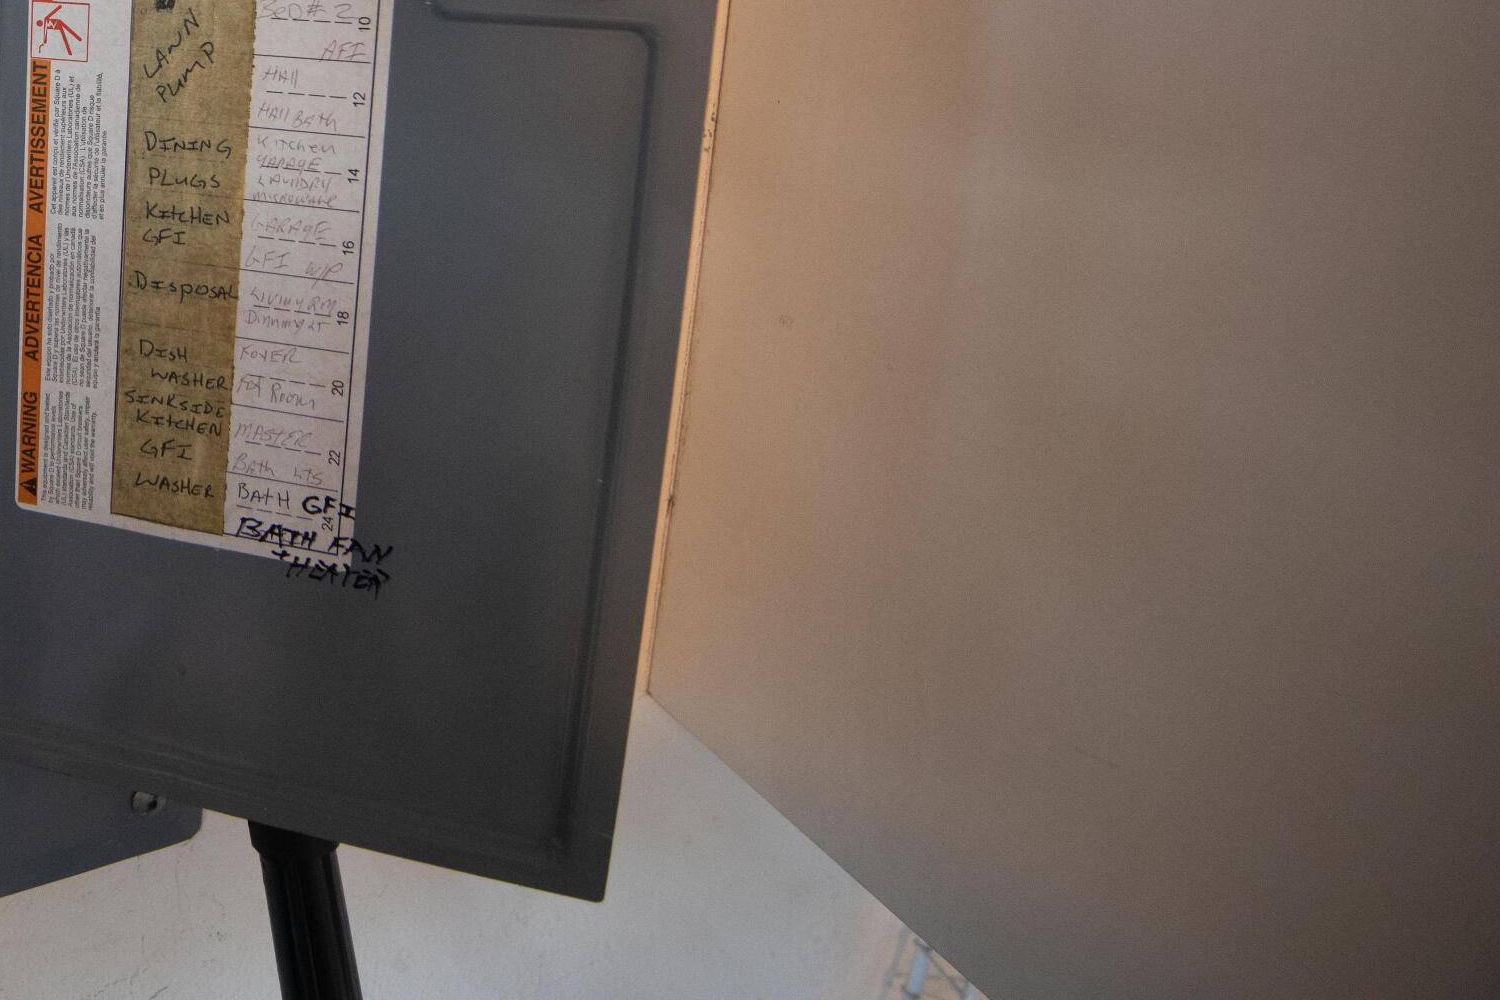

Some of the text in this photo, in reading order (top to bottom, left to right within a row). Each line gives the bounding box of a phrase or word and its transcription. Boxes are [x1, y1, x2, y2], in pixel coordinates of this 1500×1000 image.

[358, 16, 371, 32] 10
[352, 91, 366, 107] 12
[28, 60, 48, 214] AVERTISSEMENT
[144, 131, 232, 160] DINING
[347, 168, 360, 184] 14
[142, 228, 186, 247] GFI
[342, 240, 355, 256] 16
[24, 234, 42, 361] ADVERTENCIA
[336, 311, 350, 326] 18
[151, 368, 228, 391] WASHER
[331, 381, 344, 397] 20
[21, 391, 37, 473] WARNING
[139, 439, 192, 461] GFI
[328, 451, 341, 467] 22
[135, 472, 214, 498] WASHER
[301, 495, 356, 520] GFI
[321, 516, 334, 532] 24
[236, 516, 394, 564] BATH FAN
